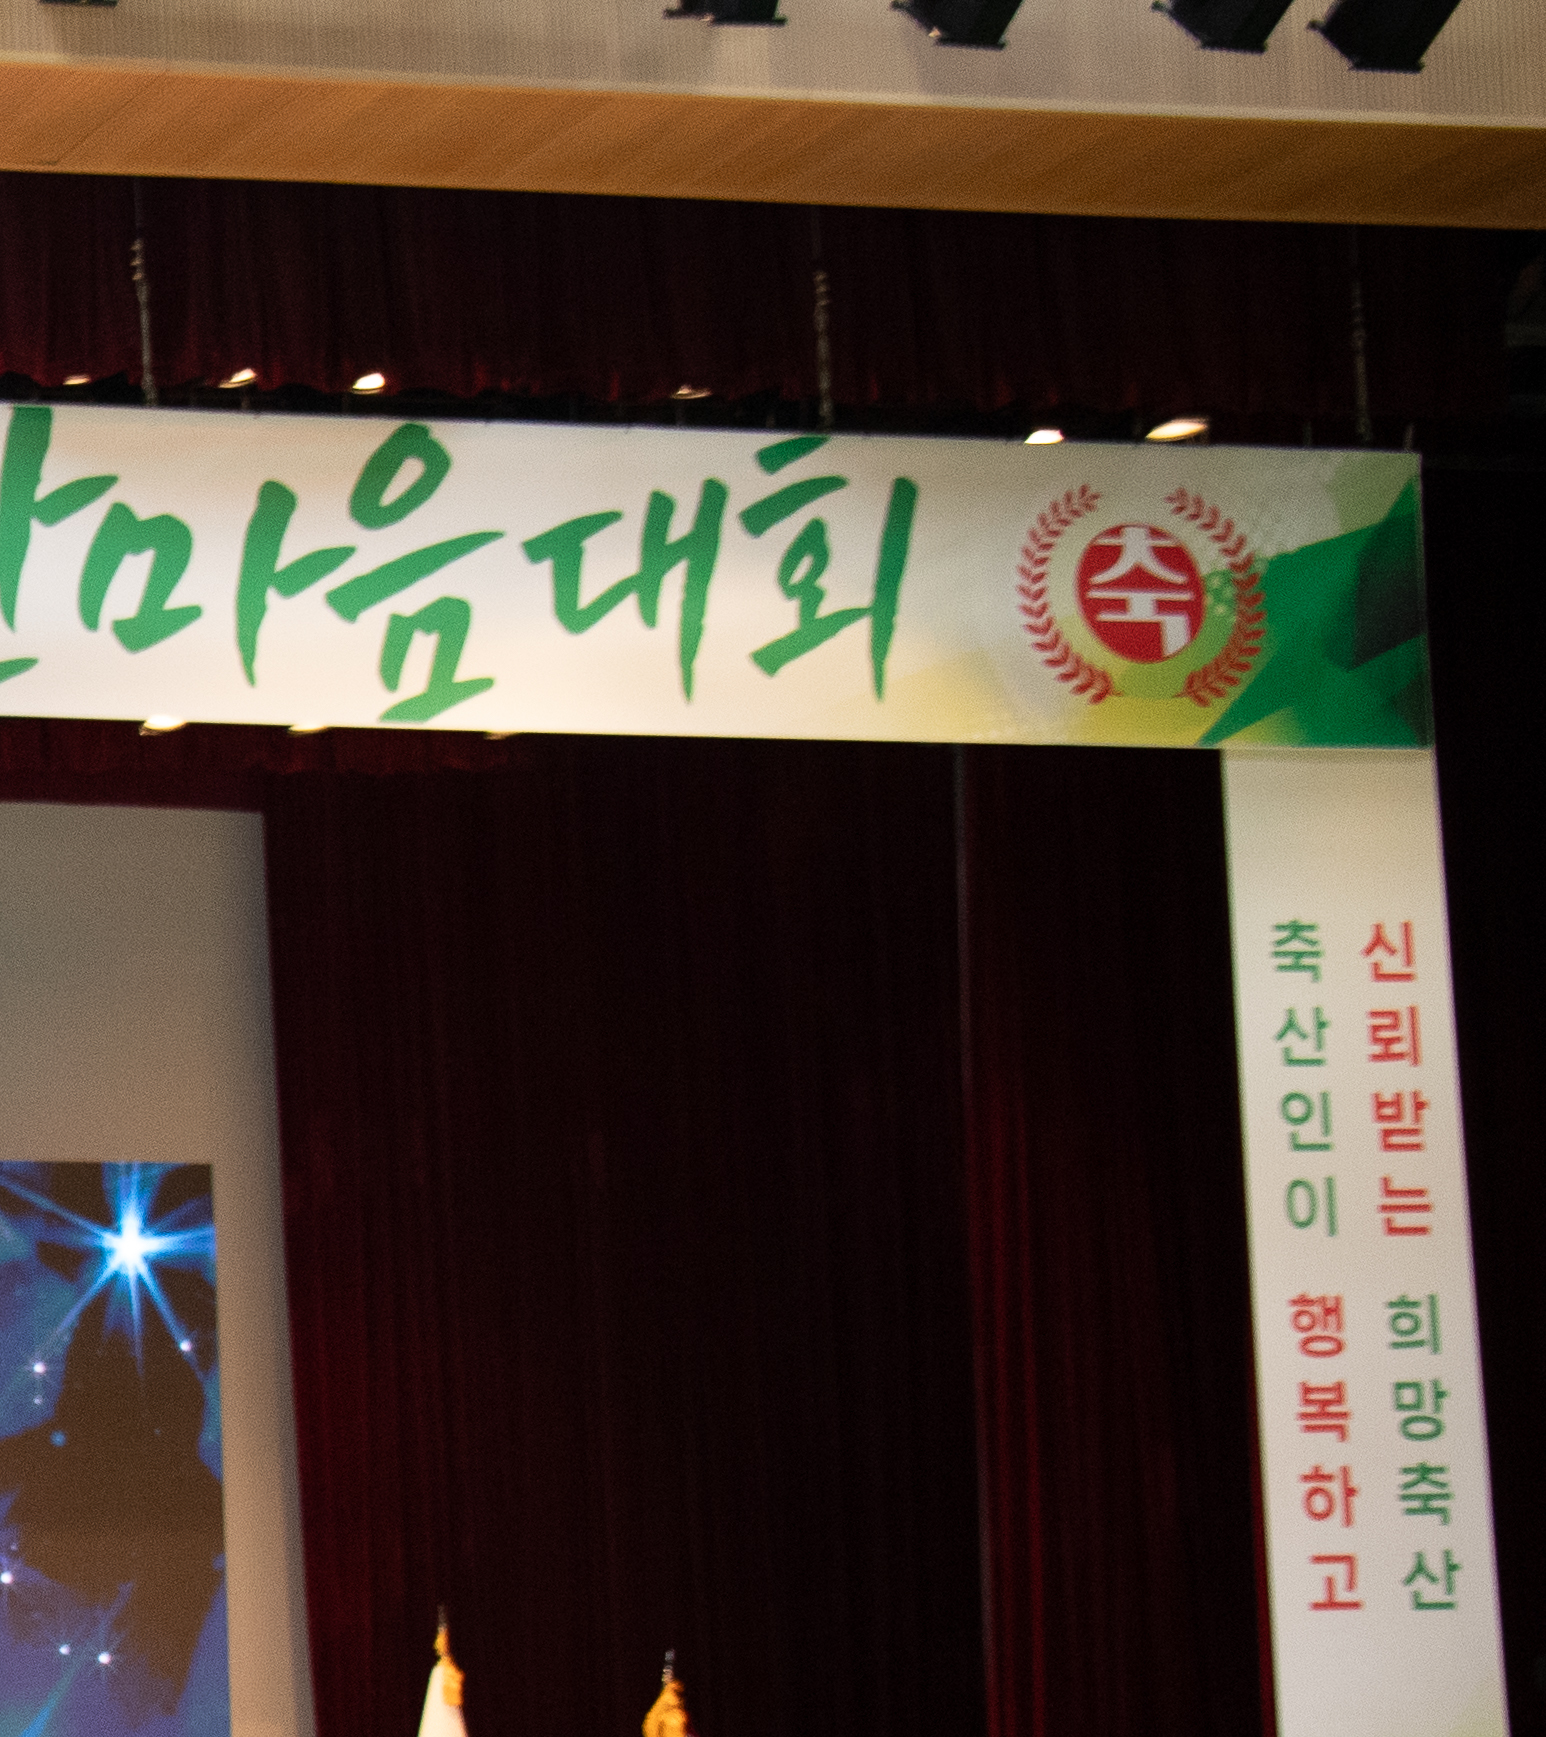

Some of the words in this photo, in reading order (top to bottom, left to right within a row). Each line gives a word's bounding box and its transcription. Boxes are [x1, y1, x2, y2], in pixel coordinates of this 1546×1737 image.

[1086, 527, 1195, 655] 축
[1269, 918, 1340, 1238] 축산인이
[1362, 919, 1434, 1238] 신뢰받는
[1288, 1291, 1364, 1612] 행복하고
[1386, 1291, 1462, 1612] 희망축산
